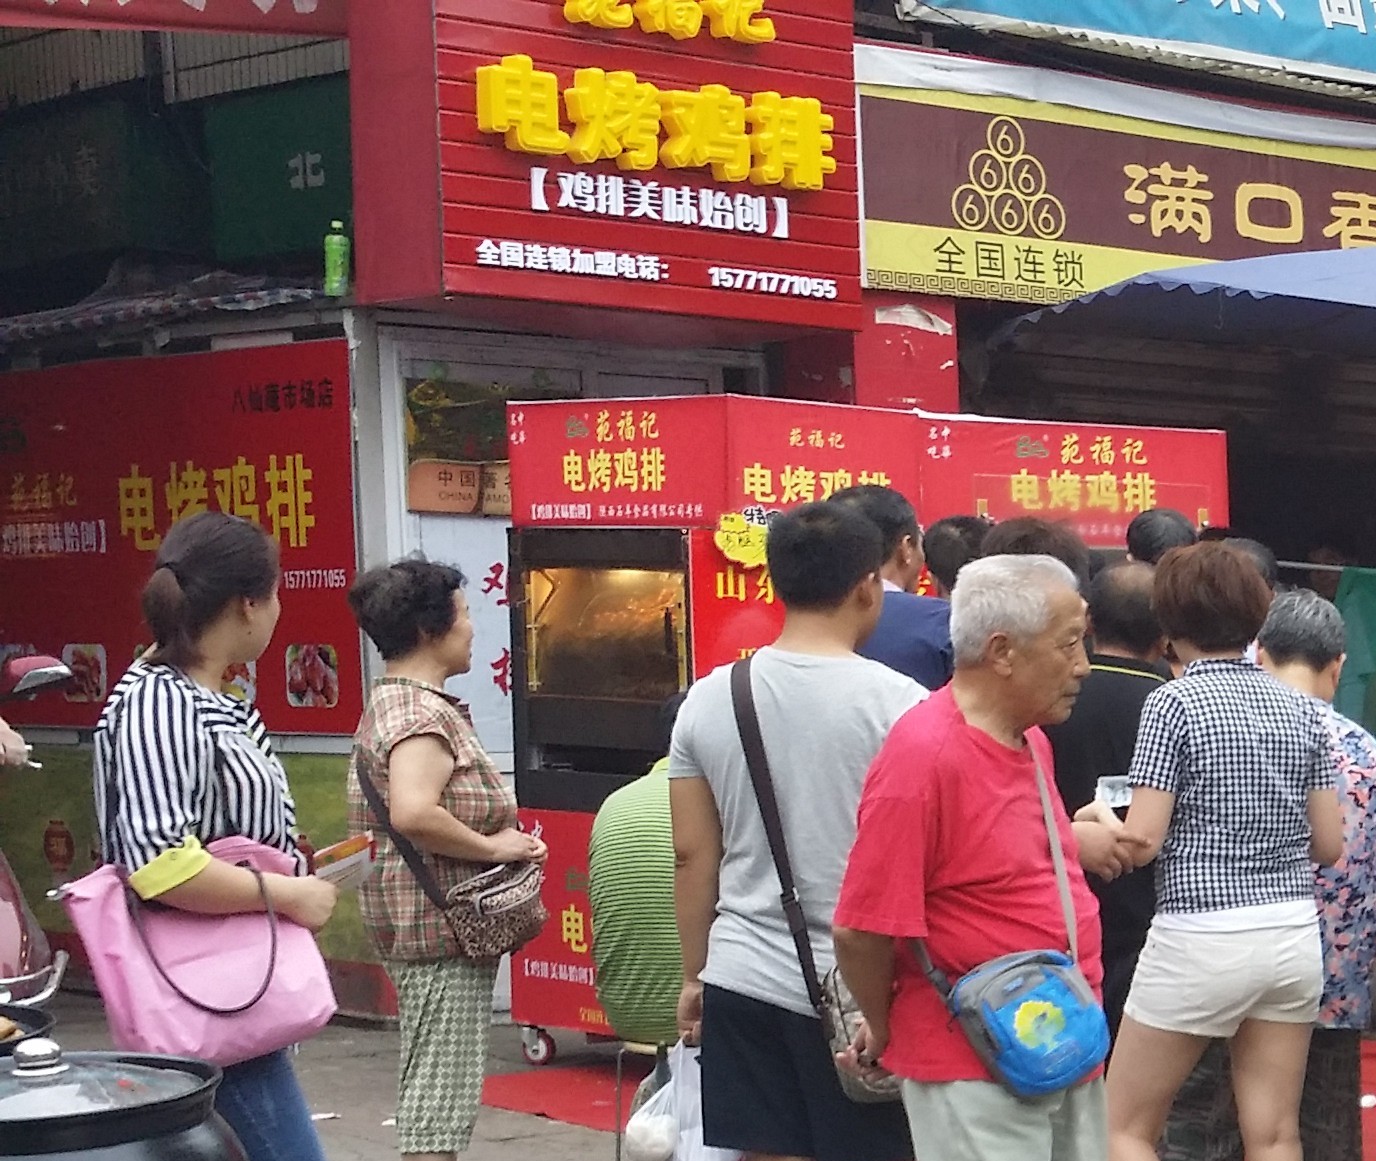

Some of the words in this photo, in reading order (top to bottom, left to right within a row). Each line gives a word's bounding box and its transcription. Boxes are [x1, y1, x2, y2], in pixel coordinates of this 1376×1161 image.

[475, 54, 837, 191] 电烤鸡排
[529, 166, 790, 239] 【鸡排美味始创】
[707, 267, 837, 300] 15771771055
[934, 236, 1085, 289] 全国连锁
[596, 408, 660, 443] 苑福记
[789, 427, 846, 450] 苑福记
[563, 446, 667, 493] 电烤鸡排
[1060, 432, 1149, 466] 苑福记
[117, 453, 316, 552] 电烤鸡排
[1010, 468, 1158, 513] 电烤鸡排
[283, 570, 347, 591] 15771771055
